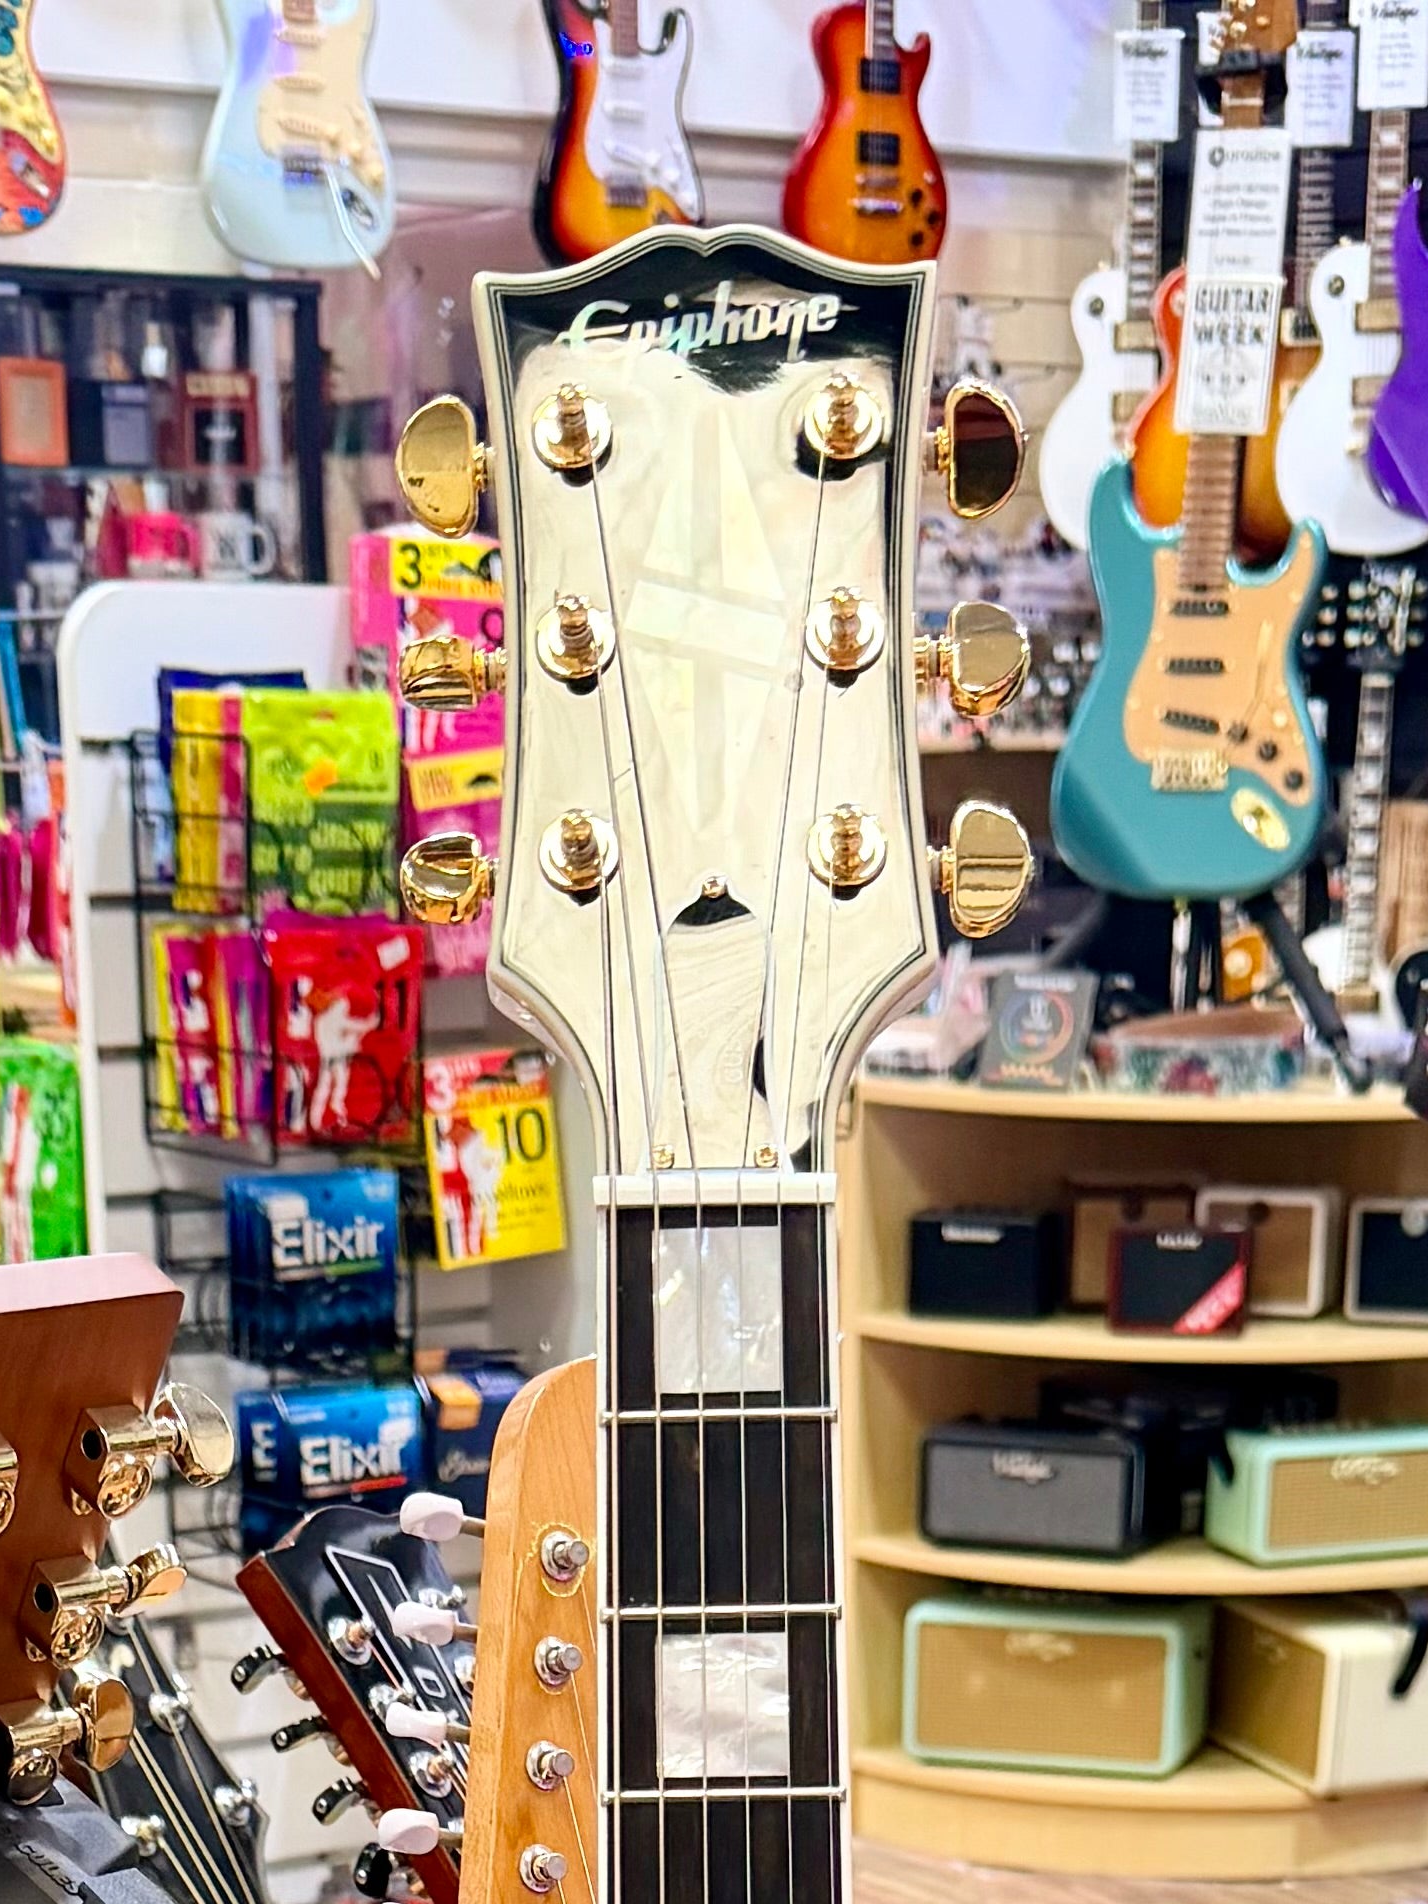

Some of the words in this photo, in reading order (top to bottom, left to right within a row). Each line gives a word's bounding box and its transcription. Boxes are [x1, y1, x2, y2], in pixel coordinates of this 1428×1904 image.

[552, 279, 840, 361] Epiphone
[399, 542, 422, 590] 3
[500, 1107, 547, 1166] 10
[272, 1215, 385, 1270] Elixir
[299, 1434, 403, 1487] Elixir
